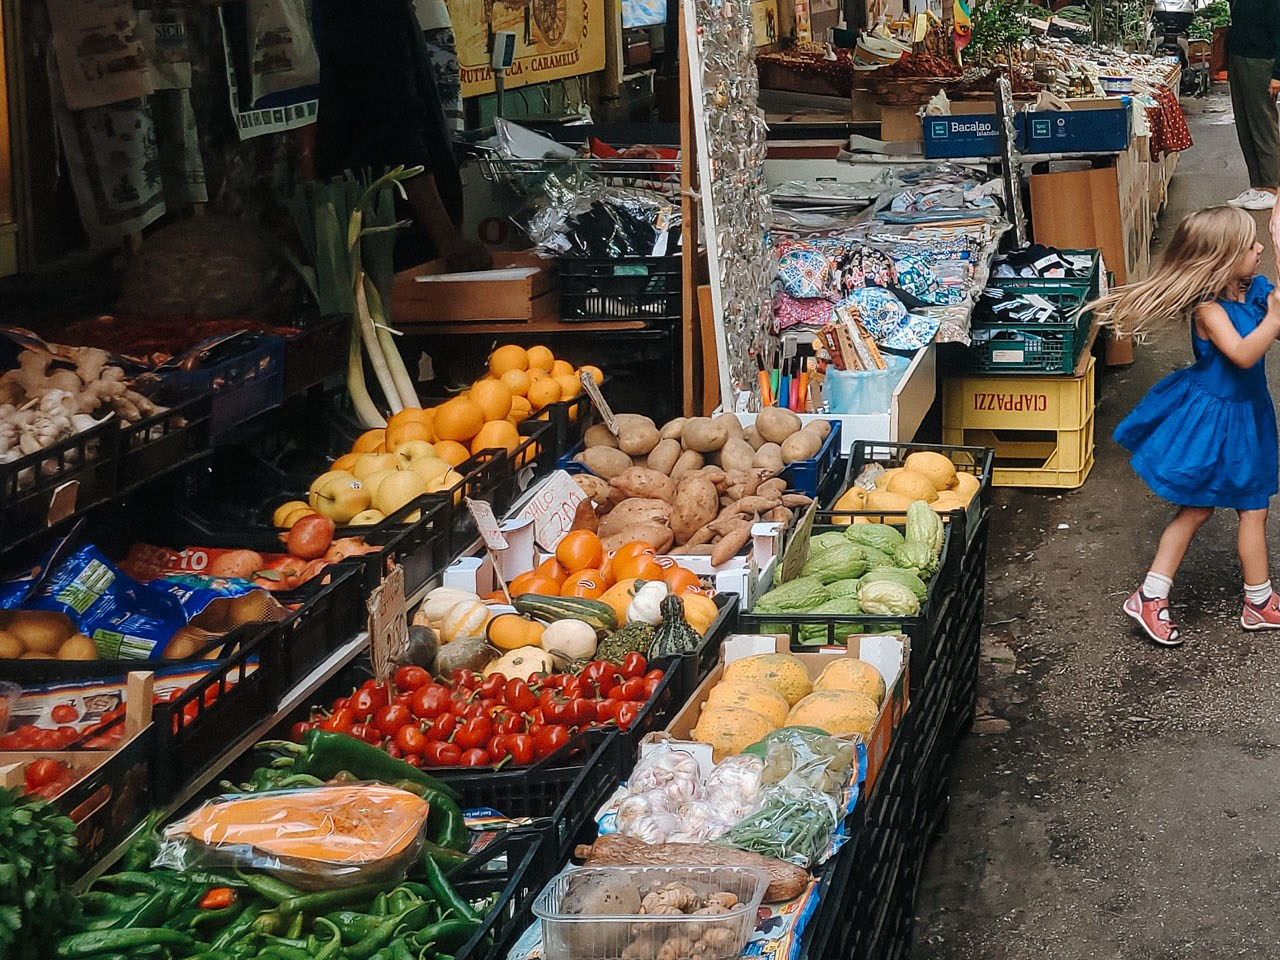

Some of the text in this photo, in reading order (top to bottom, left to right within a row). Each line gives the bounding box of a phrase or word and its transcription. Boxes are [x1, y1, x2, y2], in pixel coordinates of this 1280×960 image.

[459, 66, 492, 83] RUTTA
[531, 49, 580, 72] CARAMELLE
[951, 121, 991, 133] Bacalao
[974, 393, 1047, 412] CIAPPAZZI
